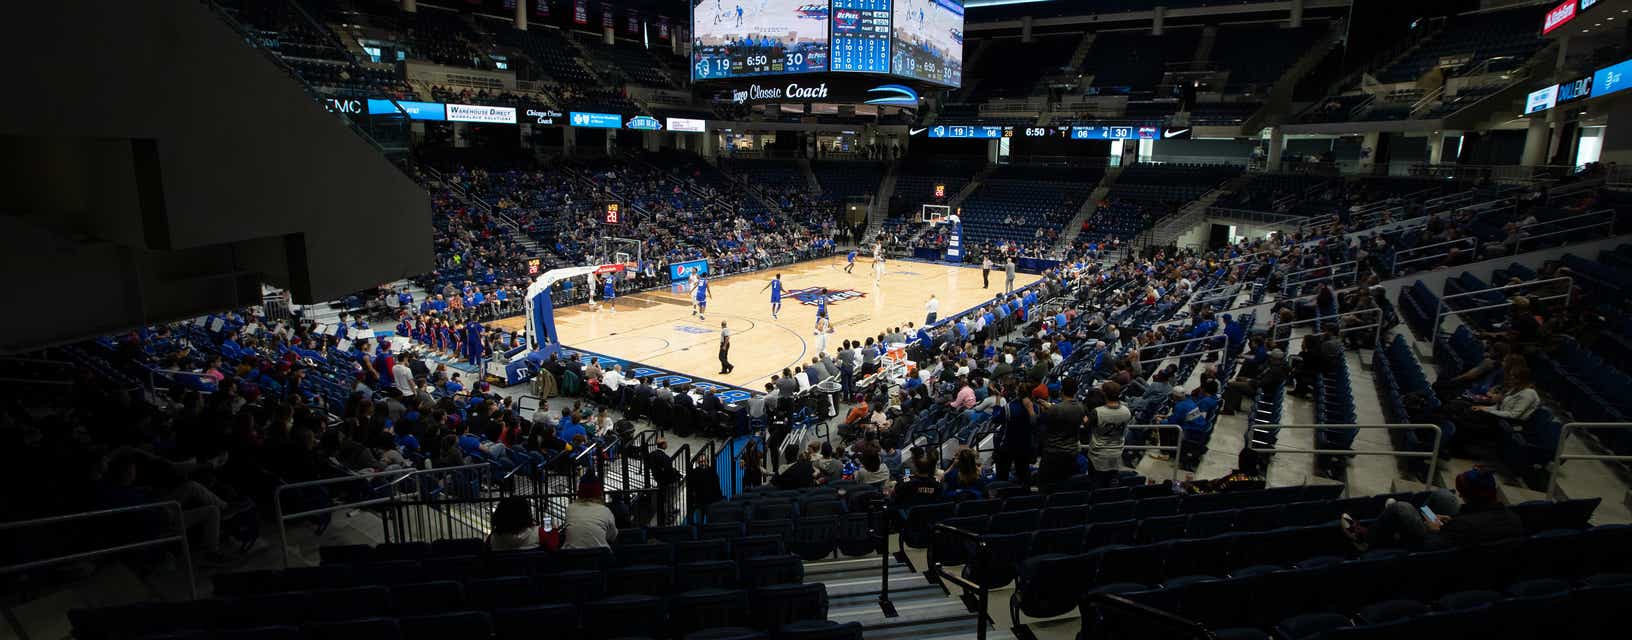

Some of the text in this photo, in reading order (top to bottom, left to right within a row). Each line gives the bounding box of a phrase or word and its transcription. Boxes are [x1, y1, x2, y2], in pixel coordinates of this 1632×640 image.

[716, 59, 729, 70] 19
[746, 56, 767, 66] 6:50
[786, 53, 802, 65] 30
[906, 58, 915, 70] 19
[944, 68, 952, 78] 30
[750, 84, 781, 100] Classic
[786, 82, 828, 98] Coach
[1026, 128, 1045, 136] 6:50
[1115, 128, 1127, 137] 30
[607, 211, 617, 222] 28
